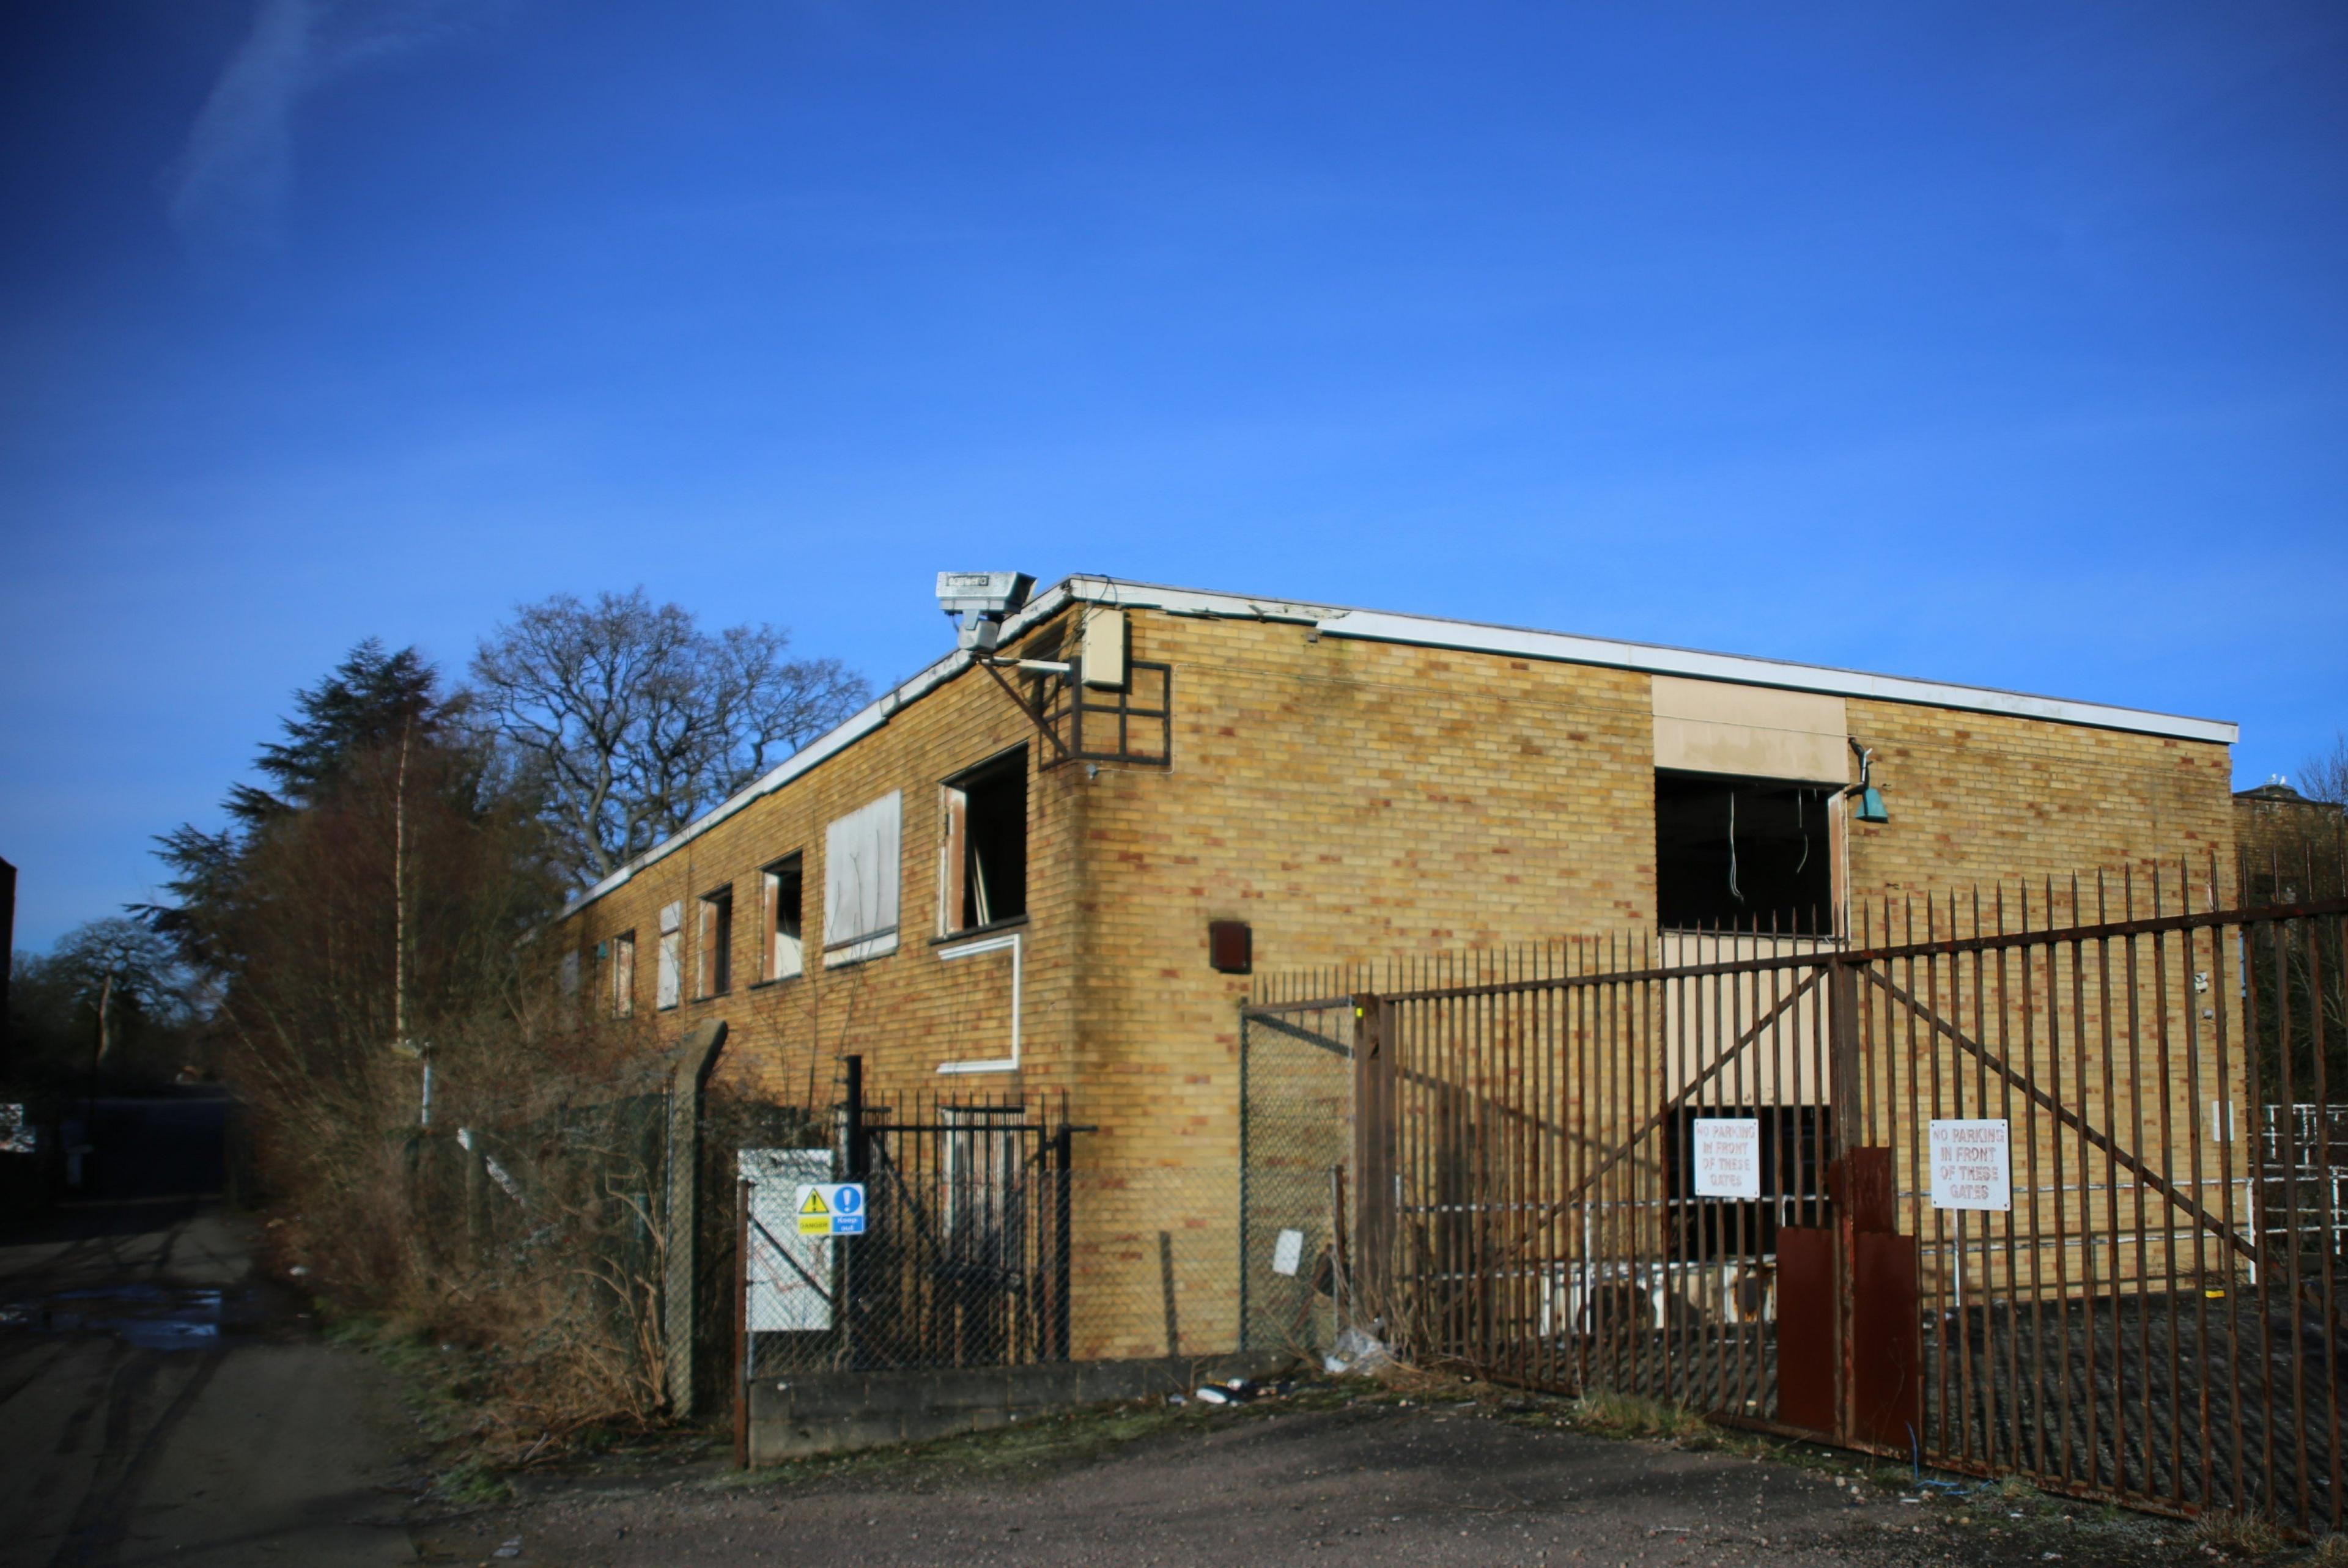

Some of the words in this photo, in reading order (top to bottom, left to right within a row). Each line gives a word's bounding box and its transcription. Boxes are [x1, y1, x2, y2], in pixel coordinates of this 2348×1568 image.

[1697, 1125, 1709, 1136] NO
[1713, 1125, 1756, 1139] PARKING
[1933, 1128, 1948, 1141] NO
[1952, 1128, 2004, 1143] PARKING
[1704, 1141, 1713, 1155] IN
[1716, 1141, 1748, 1155] FRONT
[1940, 1146, 1952, 1161] IN
[1957, 1146, 1996, 1162] FRONT
[1702, 1158, 1716, 1171] OF
[1718, 1158, 1751, 1171] THESE
[1940, 1165, 1955, 1180] OF
[1959, 1165, 1999, 1182] THESE
[1950, 1183, 1990, 1200] GATES
